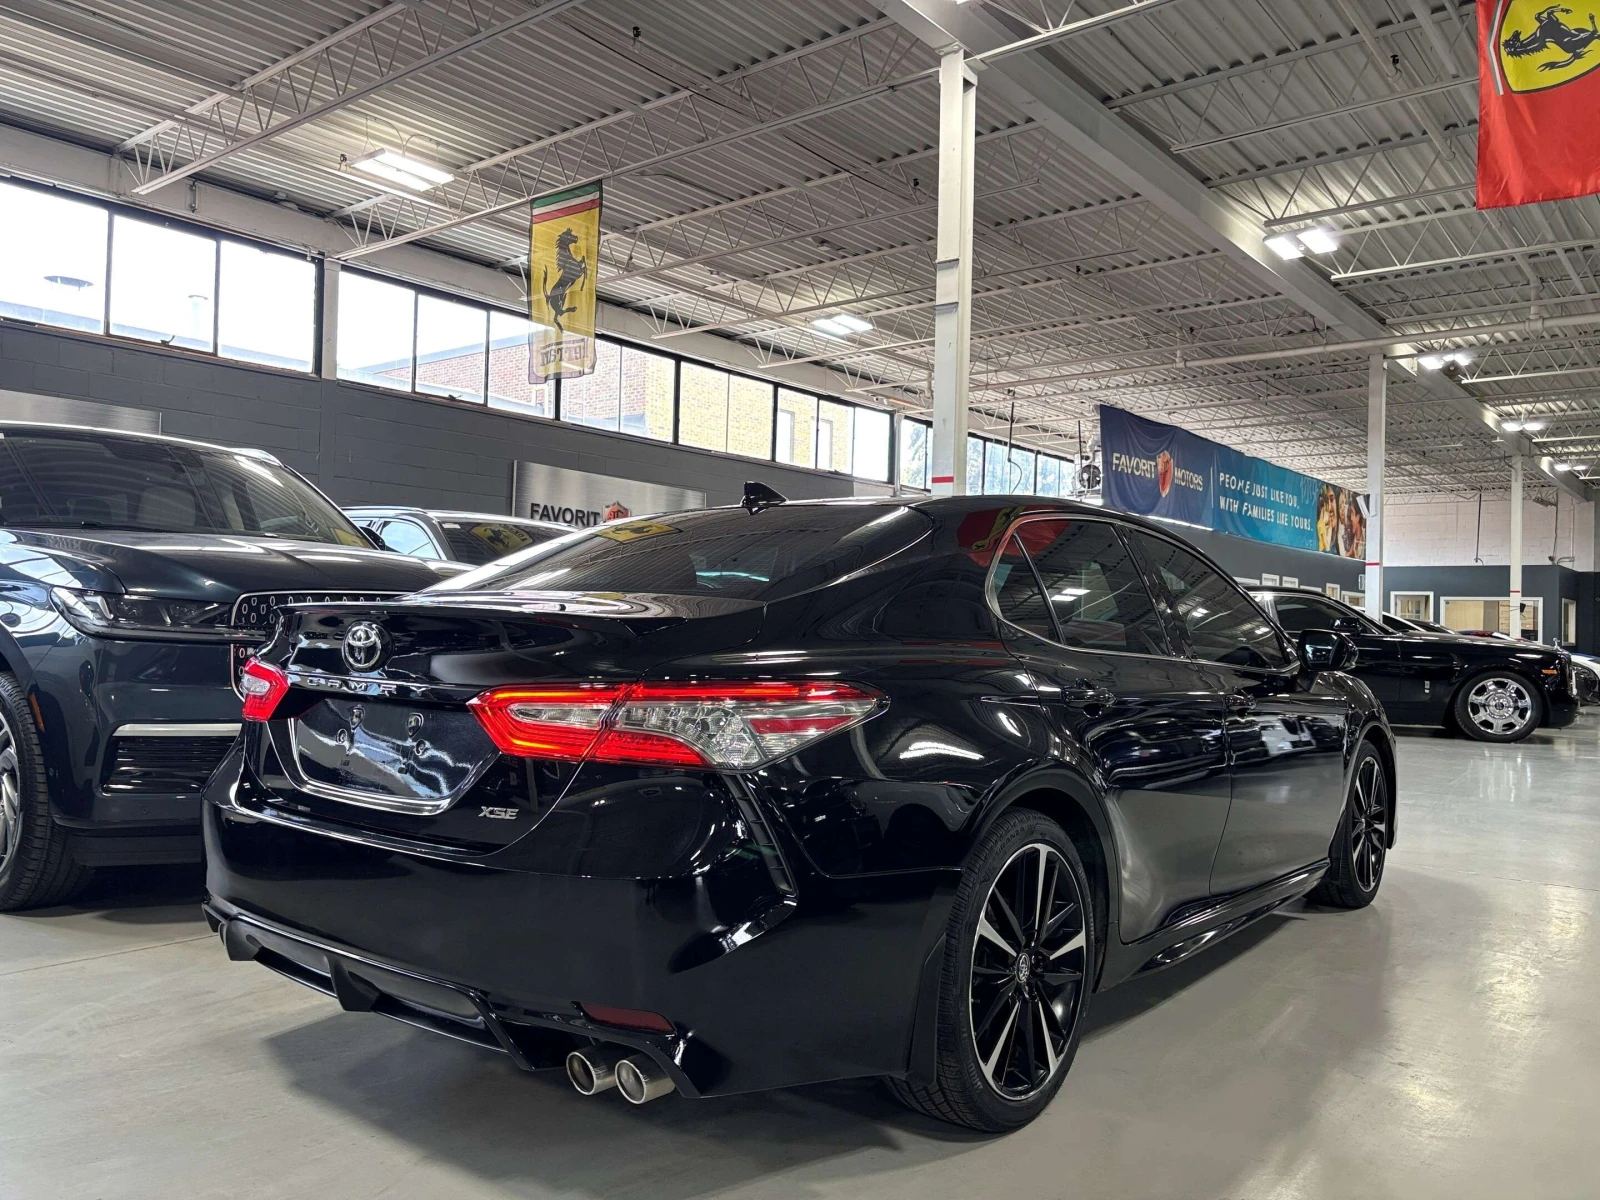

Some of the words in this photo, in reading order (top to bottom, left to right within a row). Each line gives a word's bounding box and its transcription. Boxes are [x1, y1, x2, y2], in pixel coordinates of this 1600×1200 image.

[1112, 453, 1156, 479] FAVORIT
[1174, 467, 1203, 492] MOTORS
[1252, 483, 1268, 500] JUST
[1270, 488, 1284, 504] LIKE
[530, 502, 601, 527] FAVORIT
[1219, 495, 1239, 513] WITH
[1242, 502, 1275, 523] FAMILIES
[1276, 511, 1289, 526] LIKE
[1290, 514, 1314, 532] YOURS.
[478, 806, 520, 820] XSE
